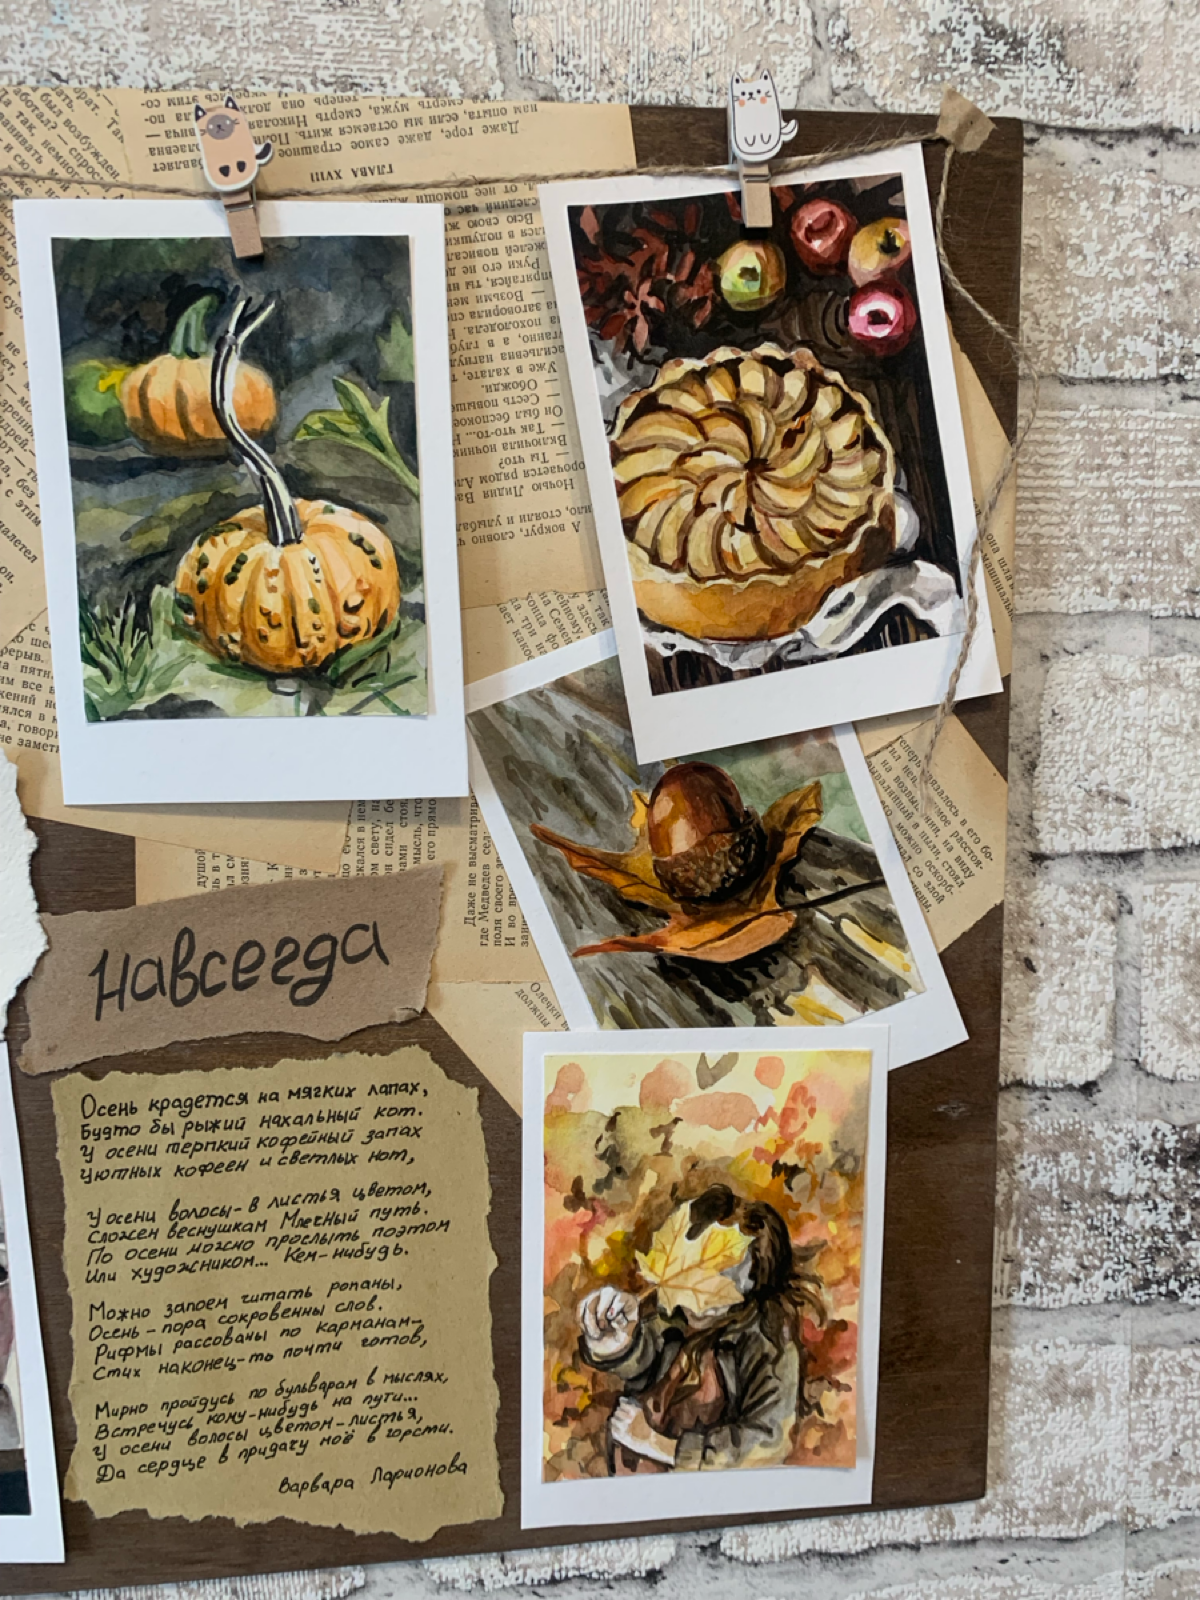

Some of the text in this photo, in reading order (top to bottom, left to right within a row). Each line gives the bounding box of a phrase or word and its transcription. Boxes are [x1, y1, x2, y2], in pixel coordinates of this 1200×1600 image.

[351, 163, 393, 178] ГЛАВА
[88, 920, 389, 1021] Навсегда
[81, 1082, 428, 1119] Осень крадется на мягких лапах,
[81, 1106, 423, 1141] Будто бы рыжий нахальный кот.
[105, 1143, 157, 1160] осени
[165, 1137, 251, 1159] терпкий
[256, 1129, 355, 1154] кофейный
[361, 1125, 423, 1145] запах
[173, 1159, 249, 1178] кофеен
[260, 1156, 272, 1166] и
[277, 1150, 359, 1166] светлых
[368, 1149, 415, 1165] нот,
[88, 1227, 159, 1244] Сложен
[167, 1219, 267, 1240] веснушкам
[369, 1201, 428, 1221] путь.
[106, 1210, 156, 1225] осени
[248, 1195, 260, 1213] в
[267, 1188, 341, 1209] листья
[352, 1181, 432, 1200] цветом,
[86, 1219, 450, 1267] По осени можно прослыть поэтом
[85, 1268, 116, 1284] Или
[88, 1301, 151, 1322] Можно
[164, 1296, 228, 1319] запоем
[241, 1286, 313, 1305] читать
[335, 1294, 382, 1313] слов.
[93, 1366, 141, 1380] Стих
[283, 1341, 343, 1359] почти
[361, 1323, 428, 1348] готов,
[94, 1343, 162, 1365] Рифмы
[173, 1326, 267, 1354] рассованы
[280, 1327, 302, 1338] по
[95, 1365, 448, 1420] Мирно пройдусь по бульварам в мыслях,
[95, 1416, 193, 1440] Встречусь
[332, 1395, 352, 1407] на
[95, 1464, 126, 1484] Да
[138, 1456, 207, 1477] сердце
[218, 1443, 229, 1464] в
[238, 1440, 309, 1464] придачу
[367, 1423, 381, 1443] в
[386, 1422, 453, 1442] горсти.
[120, 1440, 171, 1455] осени
[188, 1428, 248, 1446] волосы
[278, 1452, 467, 1498] Варвара Ларионова
